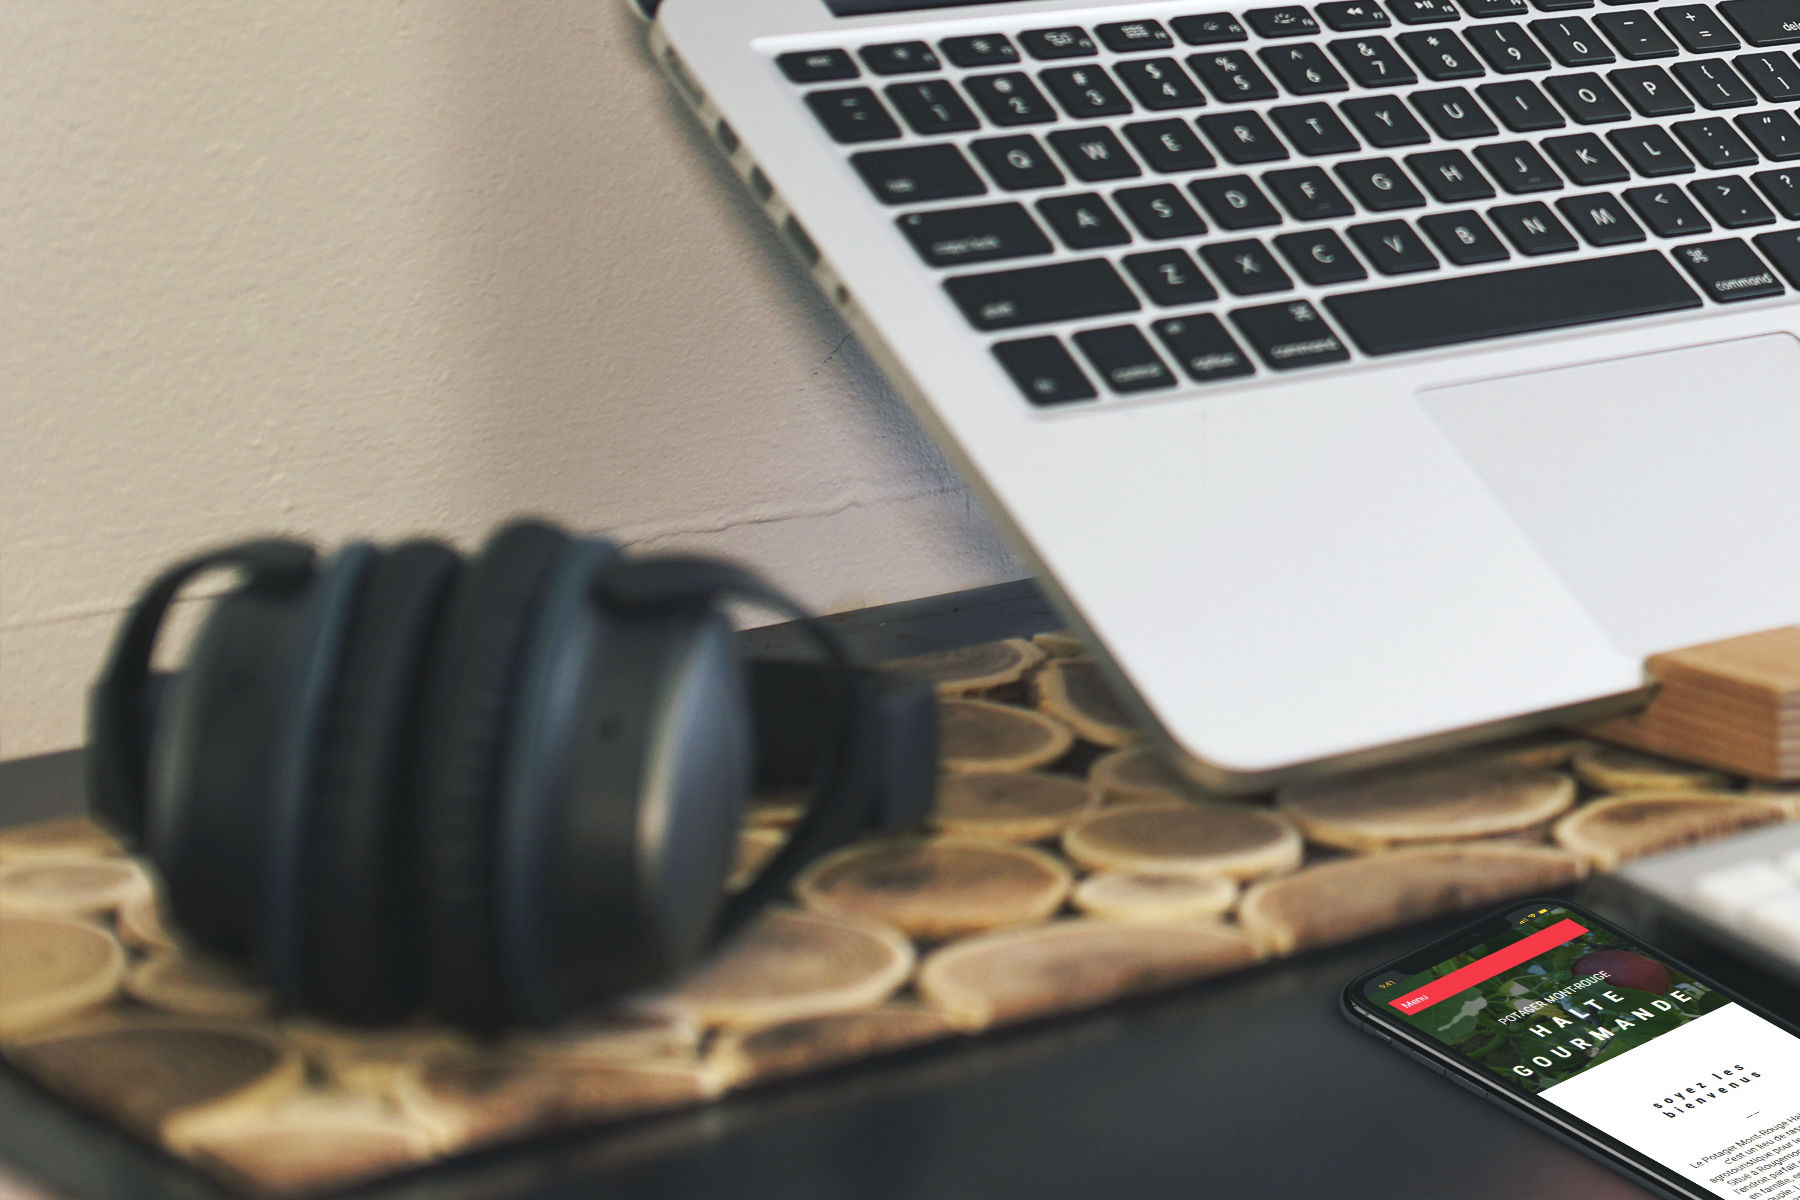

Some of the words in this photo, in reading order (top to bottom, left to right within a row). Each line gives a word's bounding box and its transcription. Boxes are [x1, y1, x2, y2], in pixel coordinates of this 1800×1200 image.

[1442, 55, 1457, 67] 8
[1508, 48, 1520, 60] 9
[1307, 69, 1320, 82] 6
[1372, 61, 1385, 74] 7
[1161, 82, 1178, 98] 4
[1234, 75, 1249, 90] 5
[1643, 82, 1656, 95] P
[1086, 90, 1103, 105] 3
[1374, 110, 1393, 127] Y
[1443, 104, 1463, 118] U
[1234, 127, 1252, 142] R
[1305, 118, 1324, 135] T
[1161, 134, 1178, 151] E
[1641, 141, 1661, 156] L
[1008, 151, 1030, 168] Q
[1082, 144, 1106, 159] W
[1576, 149, 1596, 163] K
[1515, 158, 1527, 172] J
[1372, 174, 1391, 189] G
[1440, 167, 1462, 181] H
[1301, 182, 1314, 198] F
[1226, 191, 1246, 208] D
[1152, 200, 1170, 217] S
[1591, 209, 1615, 225] M
[1523, 219, 1545, 233] N
[1456, 227, 1474, 244] B
[1383, 237, 1404, 253] V
[1312, 245, 1332, 263] C
[1235, 255, 1260, 274] X
[1158, 263, 1184, 285] Z
[1716, 272, 1774, 291] command
[1400, 994, 1429, 1008] Menu
[1497, 999, 1549, 1026] POTAGER
[1543, 970, 1611, 1004] MONT-ROUGE
[1528, 990, 1625, 1038] HALTE
[1512, 990, 1692, 1078] GOURMANDE
[1652, 1082, 1707, 1110] soyez
[1711, 1062, 1745, 1080] les
[1662, 1070, 1762, 1120] bienvenus
